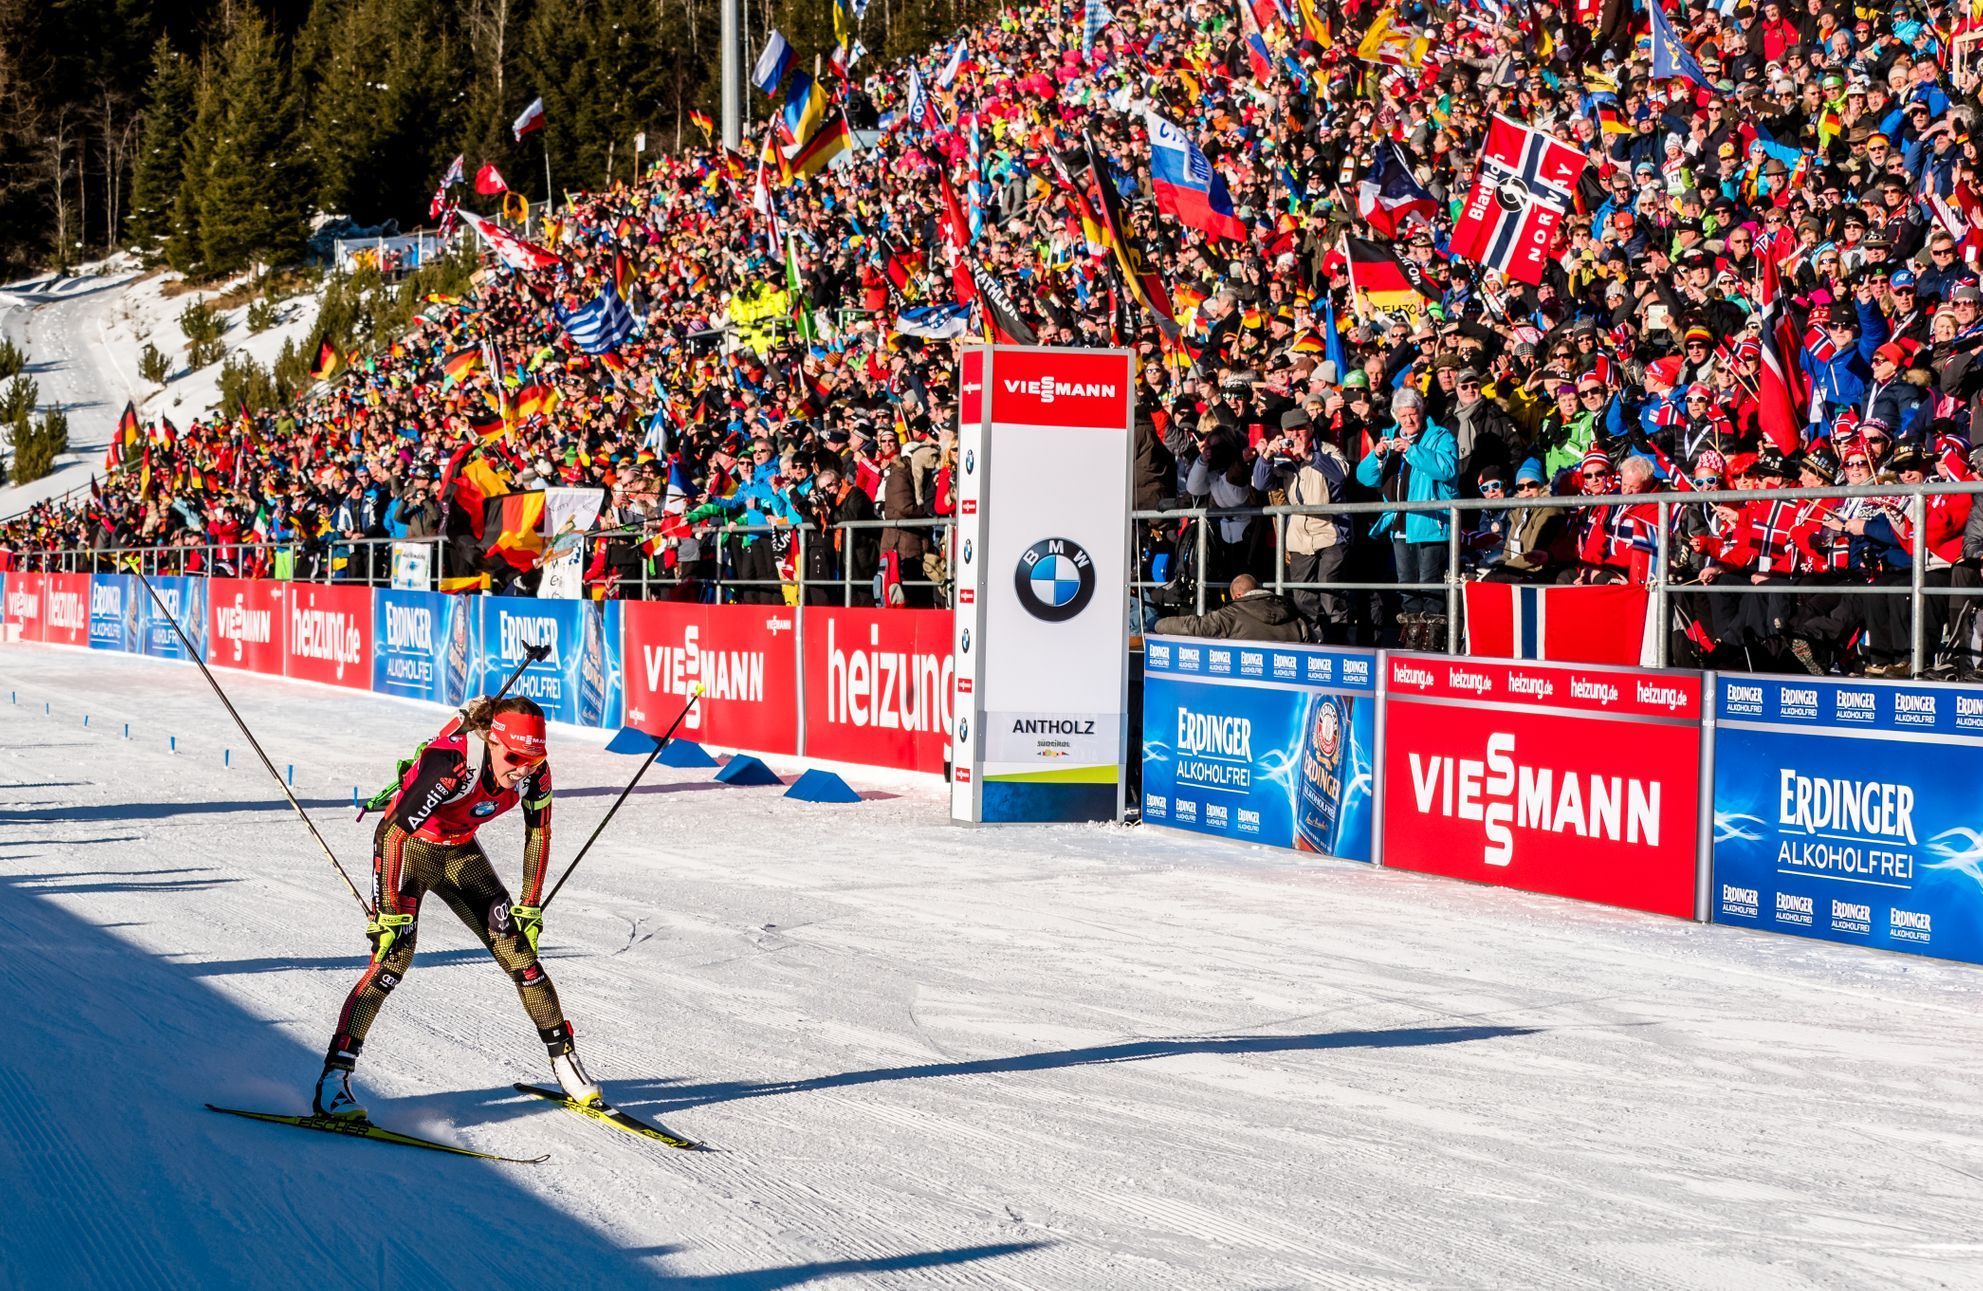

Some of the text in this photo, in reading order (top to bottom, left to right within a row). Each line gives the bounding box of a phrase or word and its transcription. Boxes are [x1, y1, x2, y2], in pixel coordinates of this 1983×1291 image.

[1528, 163, 1573, 262] NORWAY
[1004, 376, 1116, 403] VIESSMANN
[1023, 540, 1090, 567] BMW
[217, 593, 271, 661] VIESSMANN
[291, 588, 361, 680] heizung.de
[385, 601, 433, 656] ERDINGER
[500, 610, 562, 670] ERDINGER
[387, 658, 432, 682] ALKOHOLFREI
[643, 625, 764, 729] VIESSMANN
[1394, 663, 1434, 689] heizung.de
[1450, 667, 1492, 694] heizung.de
[1508, 671, 1553, 699] heizung.de
[1571, 676, 1618, 705] heizung.de
[1637, 681, 1687, 710] heizung.de
[1727, 684, 1763, 704] ERDINGER
[1781, 688, 1818, 707] ERDINGER
[1727, 704, 1762, 713] ALKOHOLFREI
[1780, 708, 1817, 716] ALKOHOLFREI
[1836, 690, 1876, 711] ERDINGER
[1895, 693, 1936, 714] ERDINGER
[1012, 719, 1095, 734] ANTHOLZ
[1836, 710, 1874, 720] ALKOHOLFREI
[1895, 714, 1935, 723] ALKOHOLFREI
[1177, 707, 1253, 763] ERDINGER
[1176, 759, 1250, 786] ALKOHOLFREI
[407, 790, 442, 830] Audi
[1408, 732, 1661, 867] VIESSMANN
[1779, 769, 1918, 845] ERDINGER
[1777, 840, 1913, 879] ALKOHOLFREI
[1723, 884, 1759, 907] ERDINGER
[1776, 891, 1813, 915] ERDINGER
[1722, 904, 1757, 915] ALKOHOLFREI
[1776, 911, 1812, 923] ALKOHOLFREI
[1832, 899, 1871, 923] ERDINGER
[1891, 907, 1931, 932] ERDINGER
[1831, 920, 1870, 932] ALKOHOLFREI
[1890, 929, 1930, 941] ALKOHOLFREI
